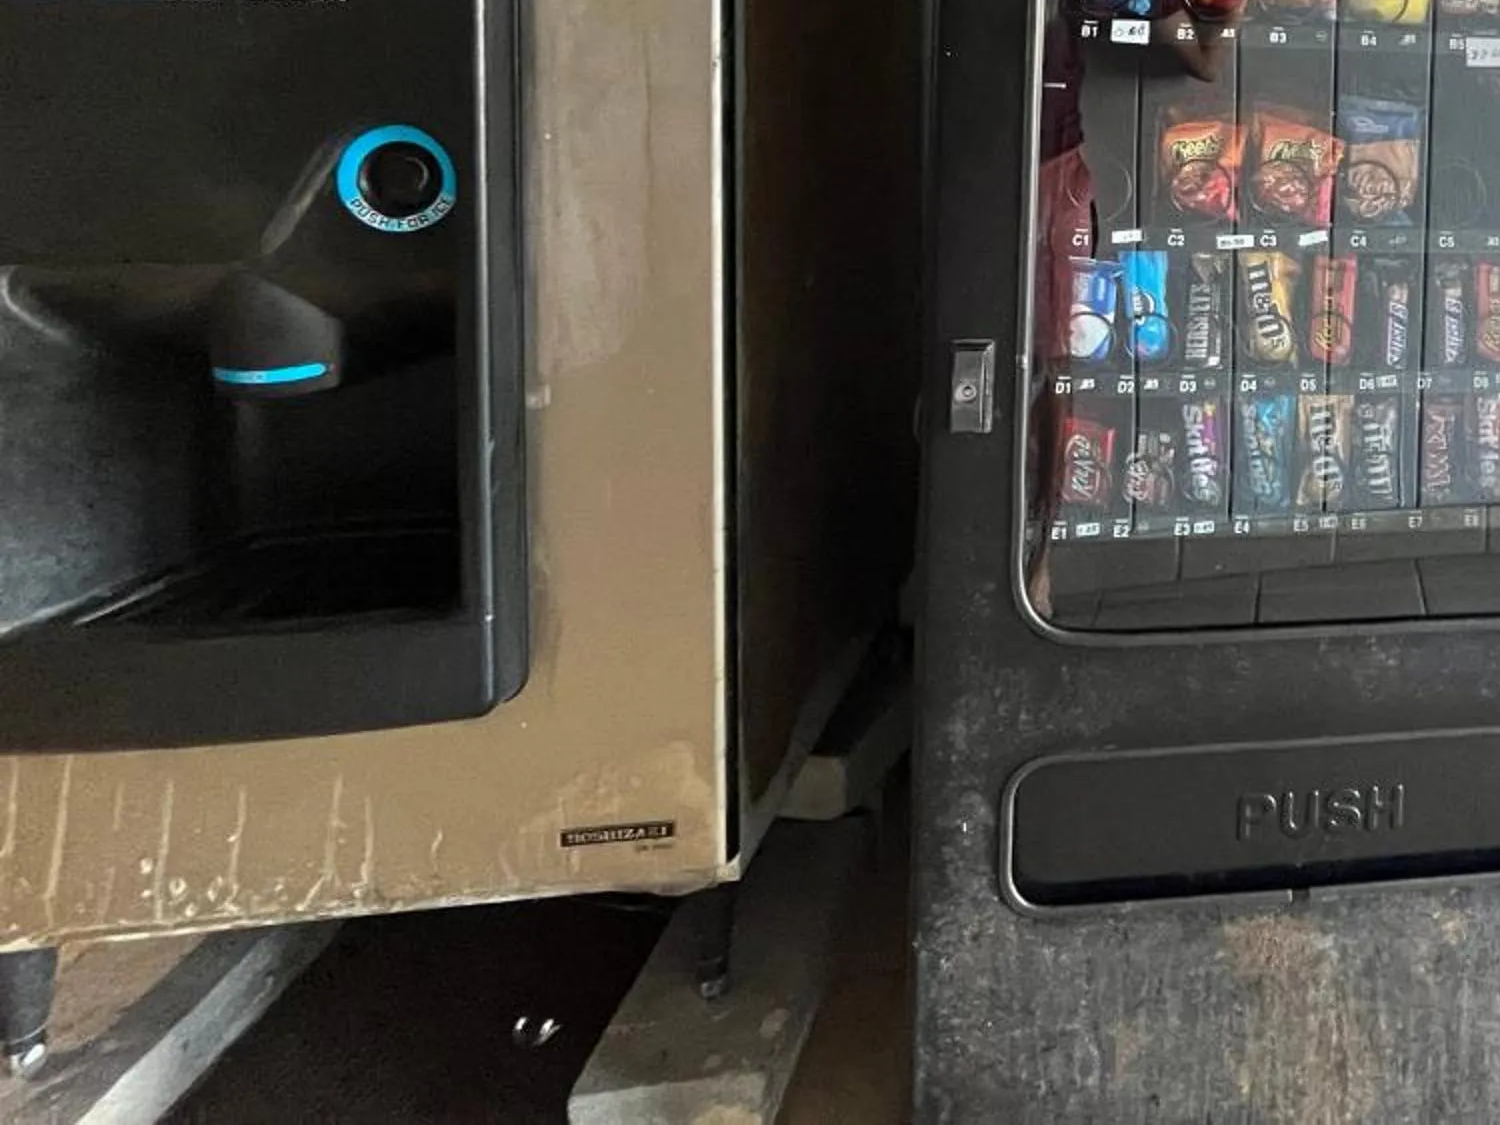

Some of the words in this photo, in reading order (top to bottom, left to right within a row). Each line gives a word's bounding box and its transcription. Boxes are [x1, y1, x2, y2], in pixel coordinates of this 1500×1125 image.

[351, 197, 389, 228] PUSH
[397, 214, 430, 229] FOR
[1072, 233, 1089, 246] C1
[1168, 234, 1185, 247] C2
[1350, 236, 1367, 248] C4
[1055, 382, 1072, 394] D1
[1179, 381, 1197, 392] D3
[1241, 380, 1257, 392] D4
[1051, 527, 1067, 540] E1
[1113, 525, 1130, 538] E2
[1236, 783, 1405, 841] PUSH
